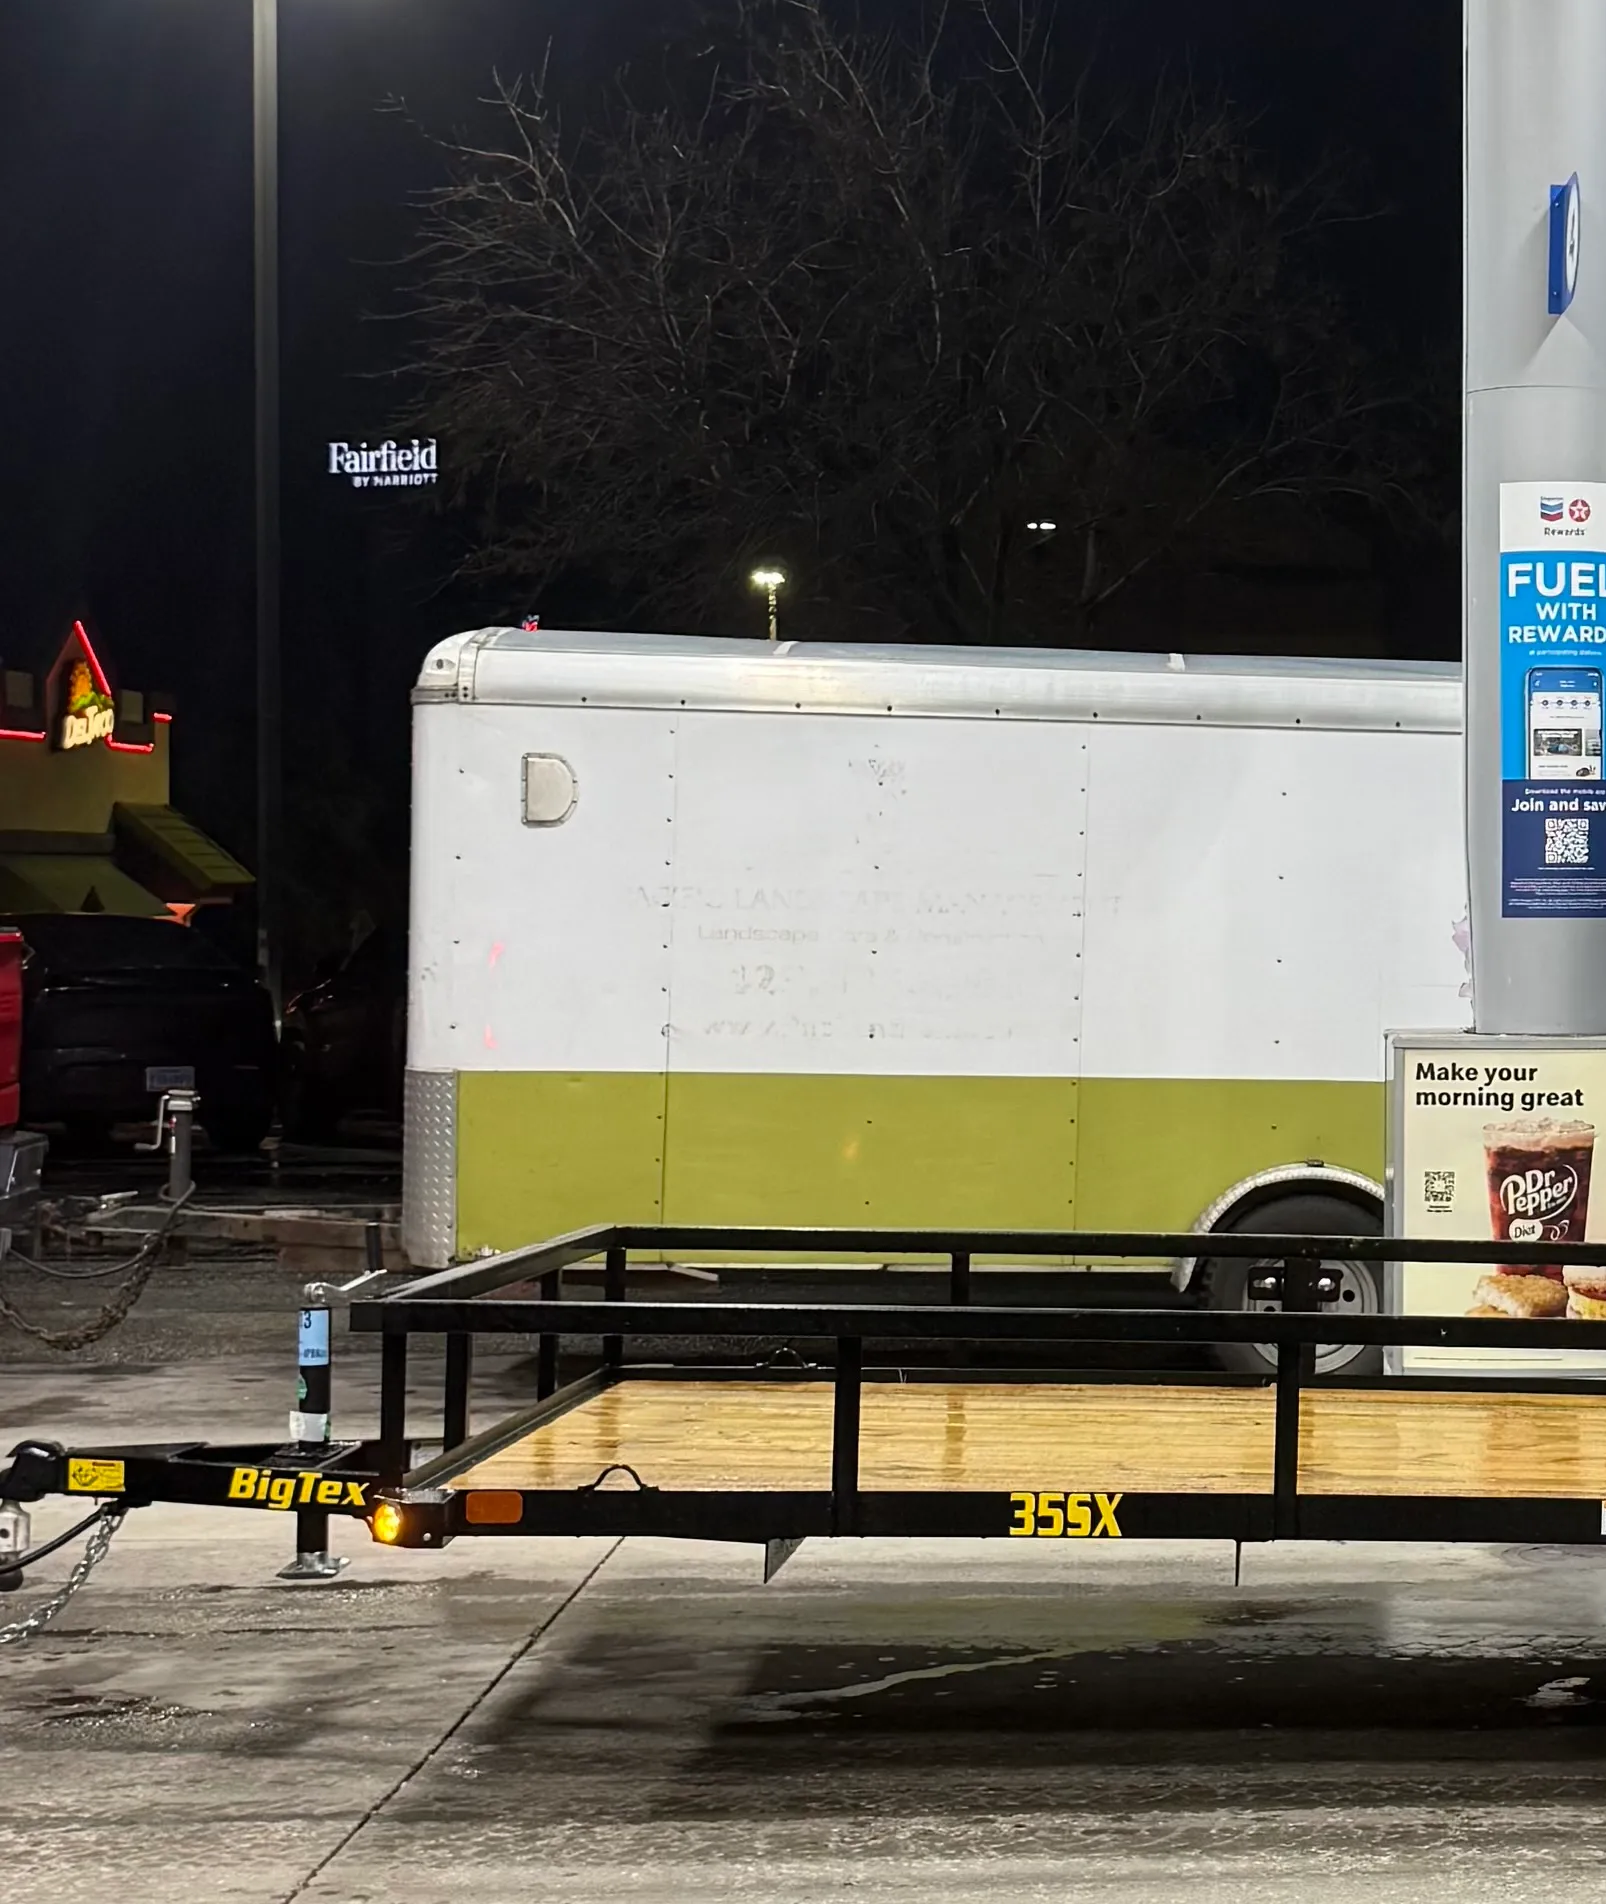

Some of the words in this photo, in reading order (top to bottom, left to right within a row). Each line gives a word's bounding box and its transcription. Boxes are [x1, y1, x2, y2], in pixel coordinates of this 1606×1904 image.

[327, 438, 438, 474] Fairfield
[352, 476, 369, 488] BY
[372, 473, 439, 487] MARRIOTT
[1543, 527, 1586, 536] Rewards
[1535, 602, 1597, 621] WITH
[1511, 797, 1545, 812] Join
[1549, 797, 1579, 812] and
[1415, 1062, 1479, 1081] Make
[1484, 1066, 1539, 1087] your
[1416, 1086, 1514, 1112] morning
[1521, 1088, 1585, 1112] great
[1525, 1169, 1556, 1194] Dr
[1500, 1174, 1573, 1216] Pepper
[228, 1466, 370, 1510] BigTex
[1009, 1492, 1124, 1537] 35SX
